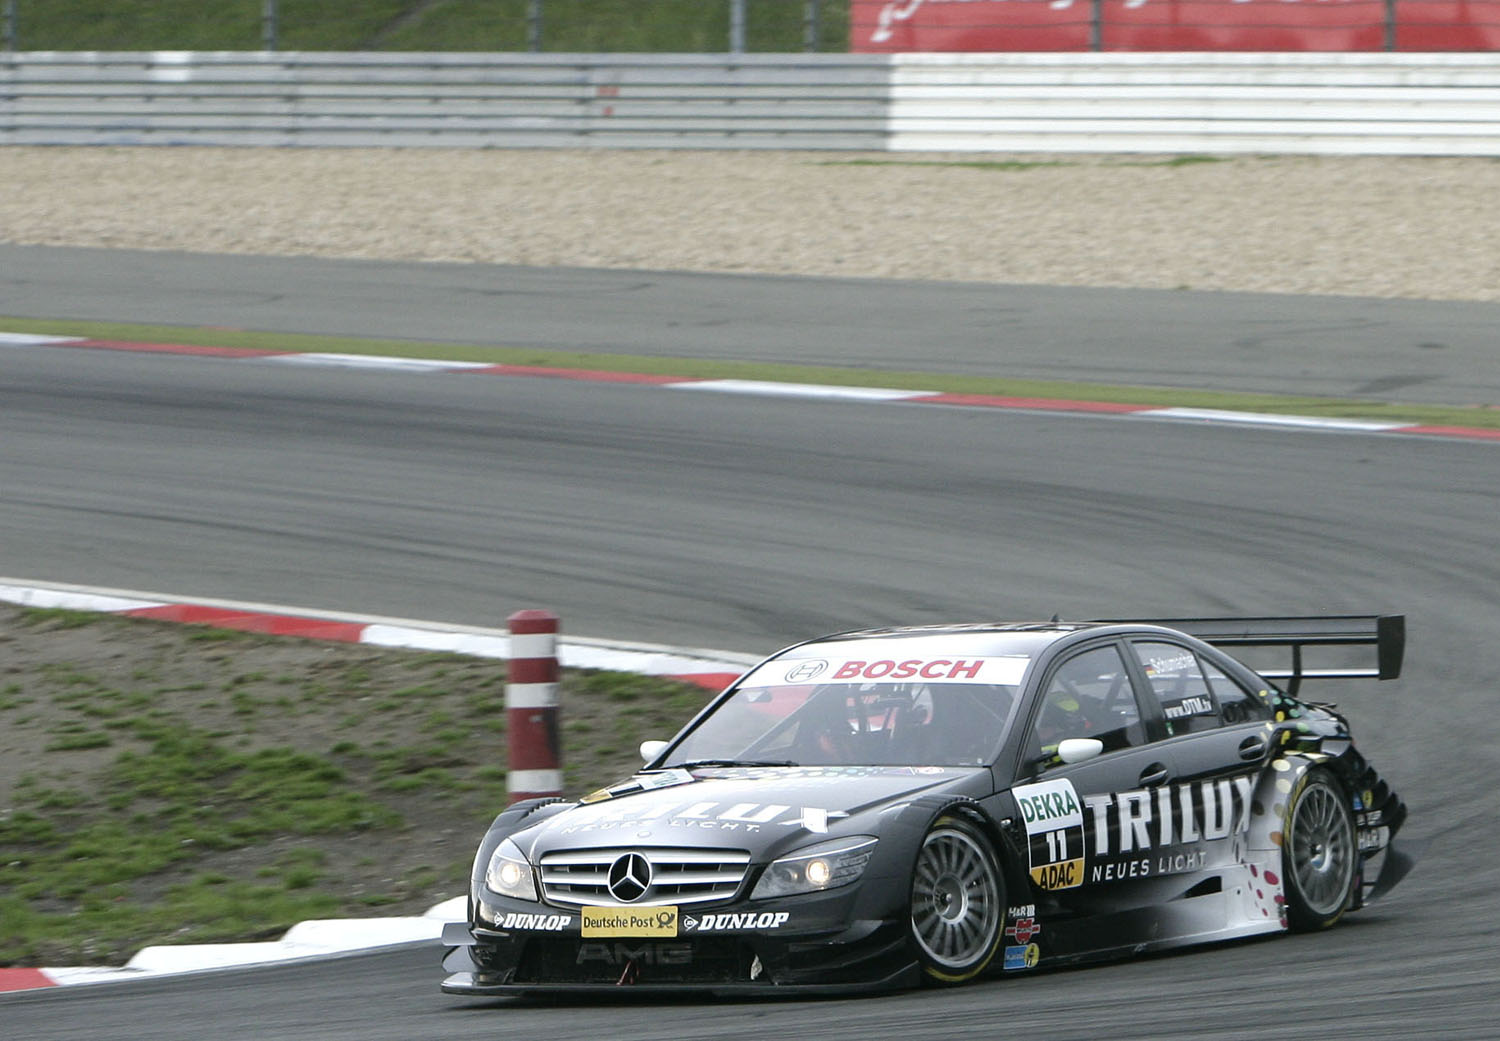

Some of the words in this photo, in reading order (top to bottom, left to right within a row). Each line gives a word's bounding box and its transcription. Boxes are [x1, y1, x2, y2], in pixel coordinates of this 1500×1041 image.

[832, 659, 985, 679] BOSCH
[1020, 789, 1080, 823] DEKRA
[1082, 772, 1260, 857] TRILUX
[1046, 829, 1068, 863] 11
[1040, 862, 1075, 891] ADAC
[1092, 859, 1150, 883] NEUES
[503, 913, 572, 931] DUNLOP
[583, 916, 628, 929] Deutsche
[630, 916, 654, 928] Post
[698, 912, 790, 931] DUNLOP
